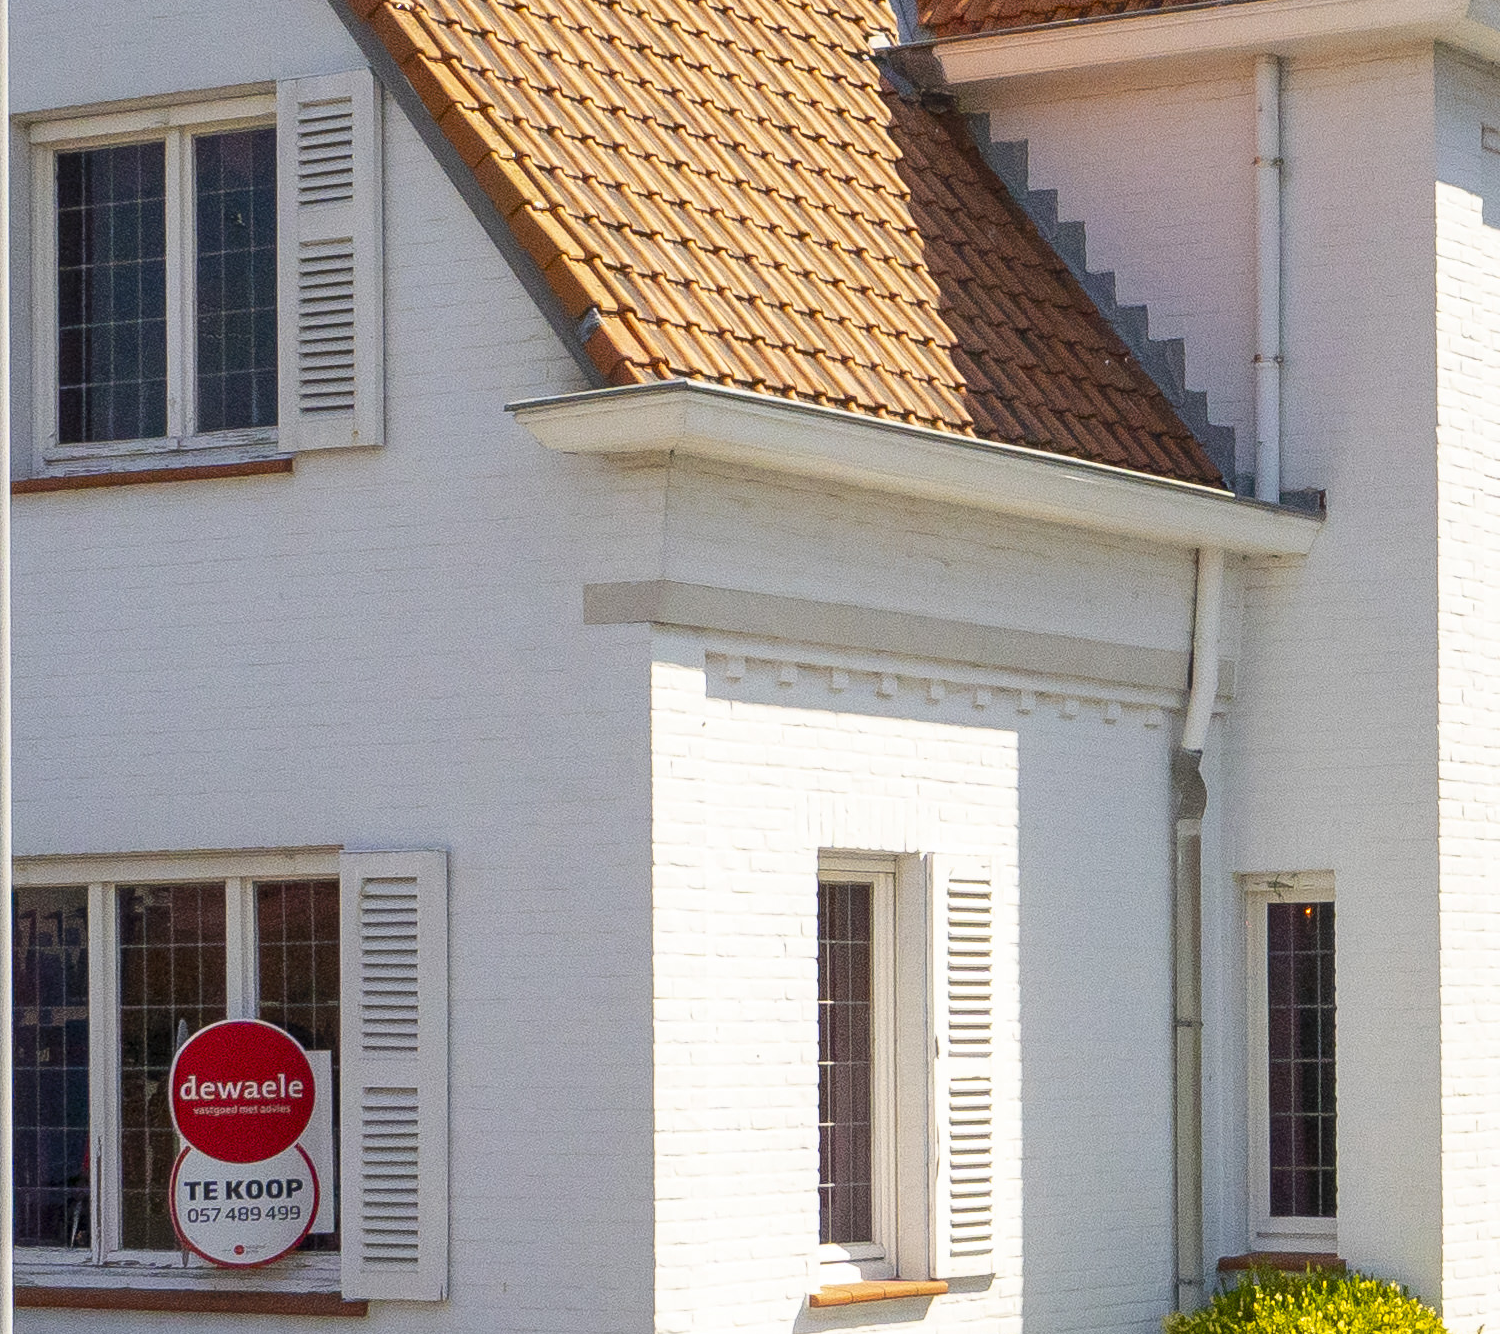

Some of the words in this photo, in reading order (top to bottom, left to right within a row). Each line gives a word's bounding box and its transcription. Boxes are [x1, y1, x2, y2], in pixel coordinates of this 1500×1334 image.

[180, 1073, 304, 1100] dewaele
[193, 1105, 238, 1116] vastgoed
[260, 1104, 291, 1114] advies
[184, 1181, 218, 1200] TE
[226, 1179, 303, 1200] KOOP
[187, 1208, 221, 1223] 057
[225, 1206, 261, 1221] 489
[265, 1205, 301, 1220] 499
